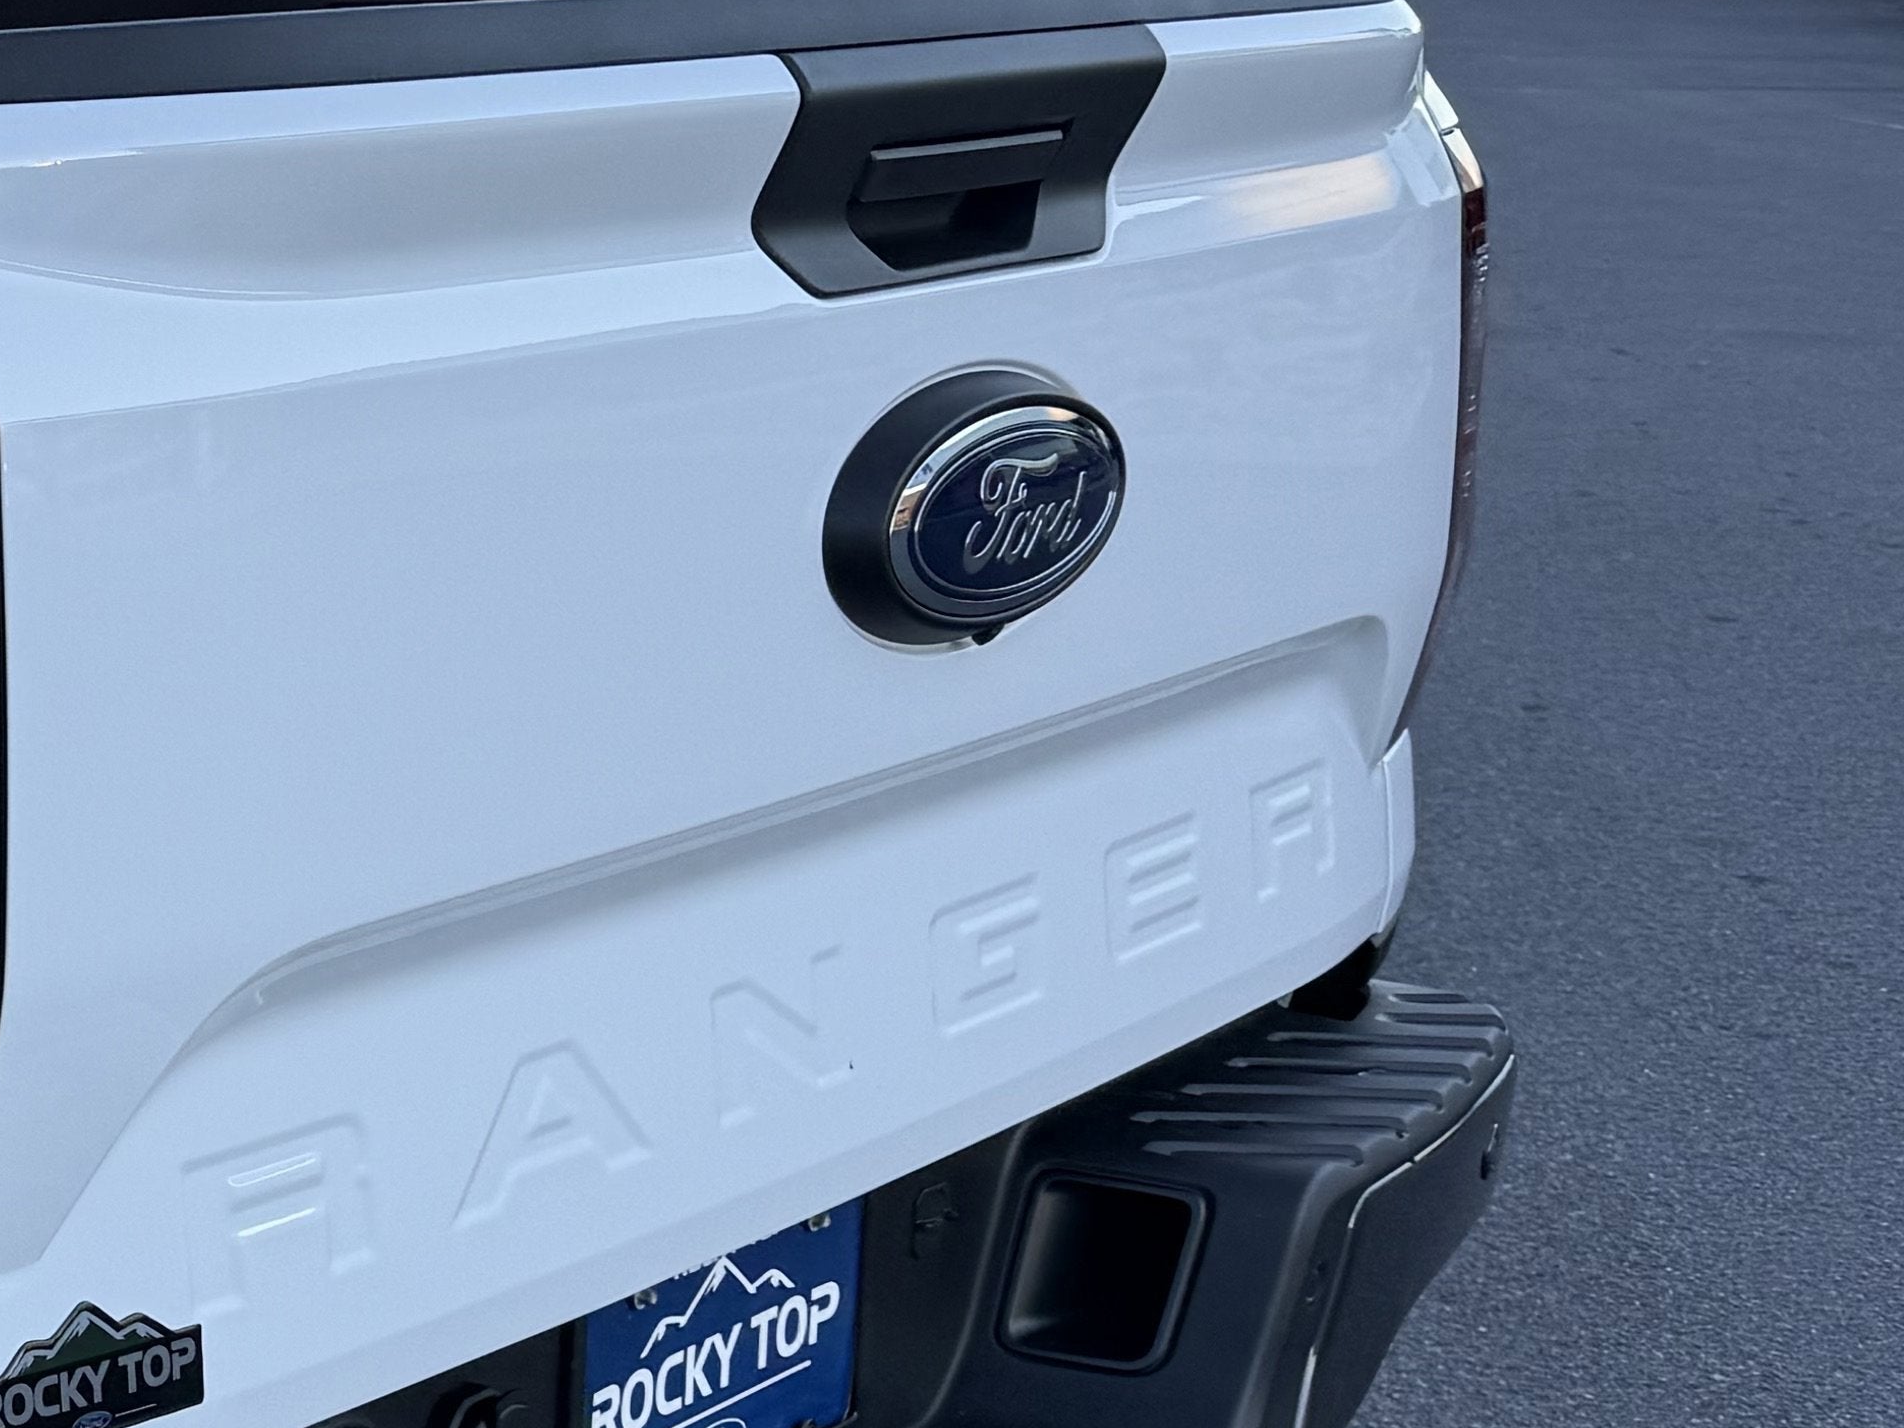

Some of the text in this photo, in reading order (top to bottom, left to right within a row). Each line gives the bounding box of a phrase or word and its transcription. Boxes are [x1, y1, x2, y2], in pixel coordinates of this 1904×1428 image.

[962, 452, 1088, 575] Ford
[180, 759, 1337, 1318] RANGER
[118, 1336, 197, 1394] TOP
[750, 1280, 841, 1371] TOP
